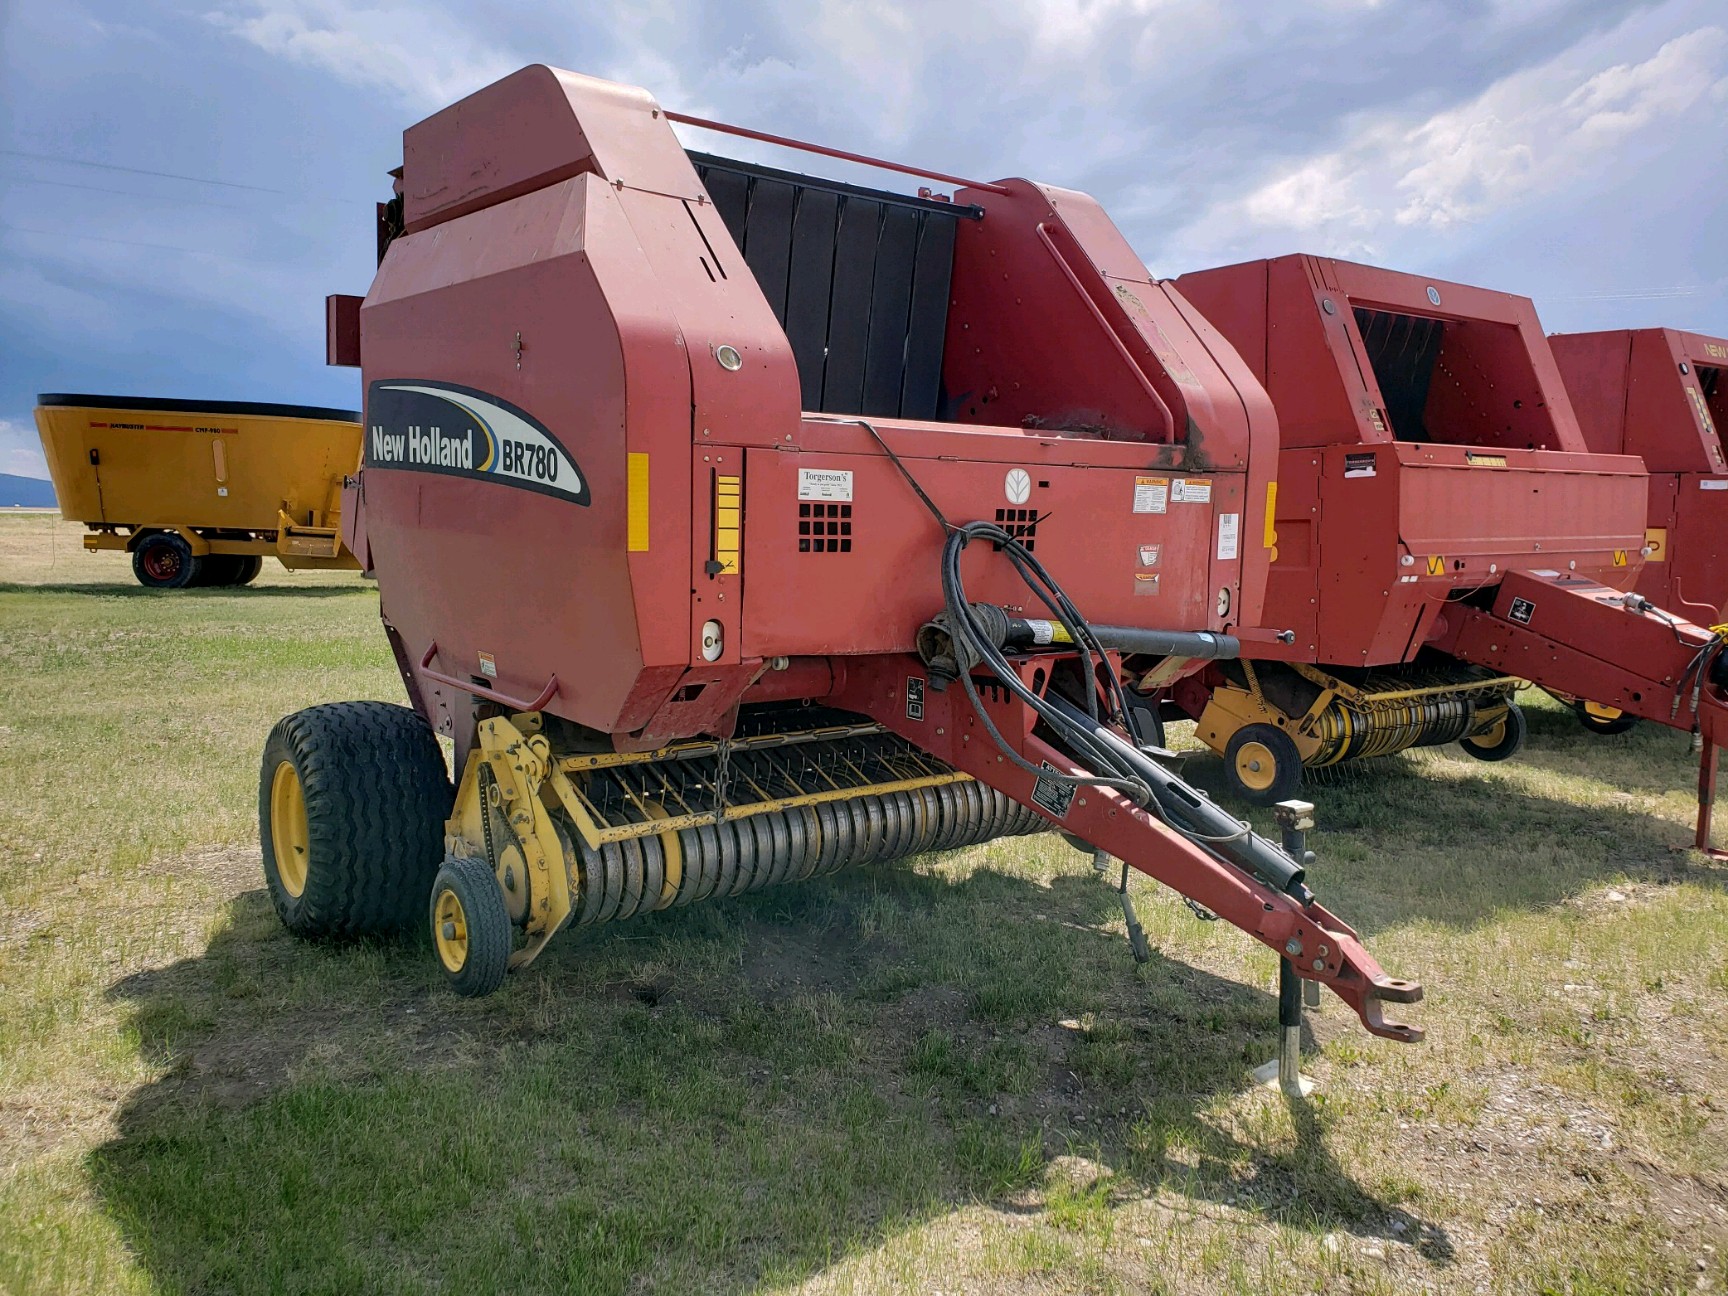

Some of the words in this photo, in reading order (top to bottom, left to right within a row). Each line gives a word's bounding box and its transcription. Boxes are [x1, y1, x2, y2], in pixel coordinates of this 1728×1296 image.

[1704, 343, 1727, 359] NEW
[372, 425, 405, 462] New
[408, 425, 473, 470] Holland
[502, 439, 558, 483] BR780
